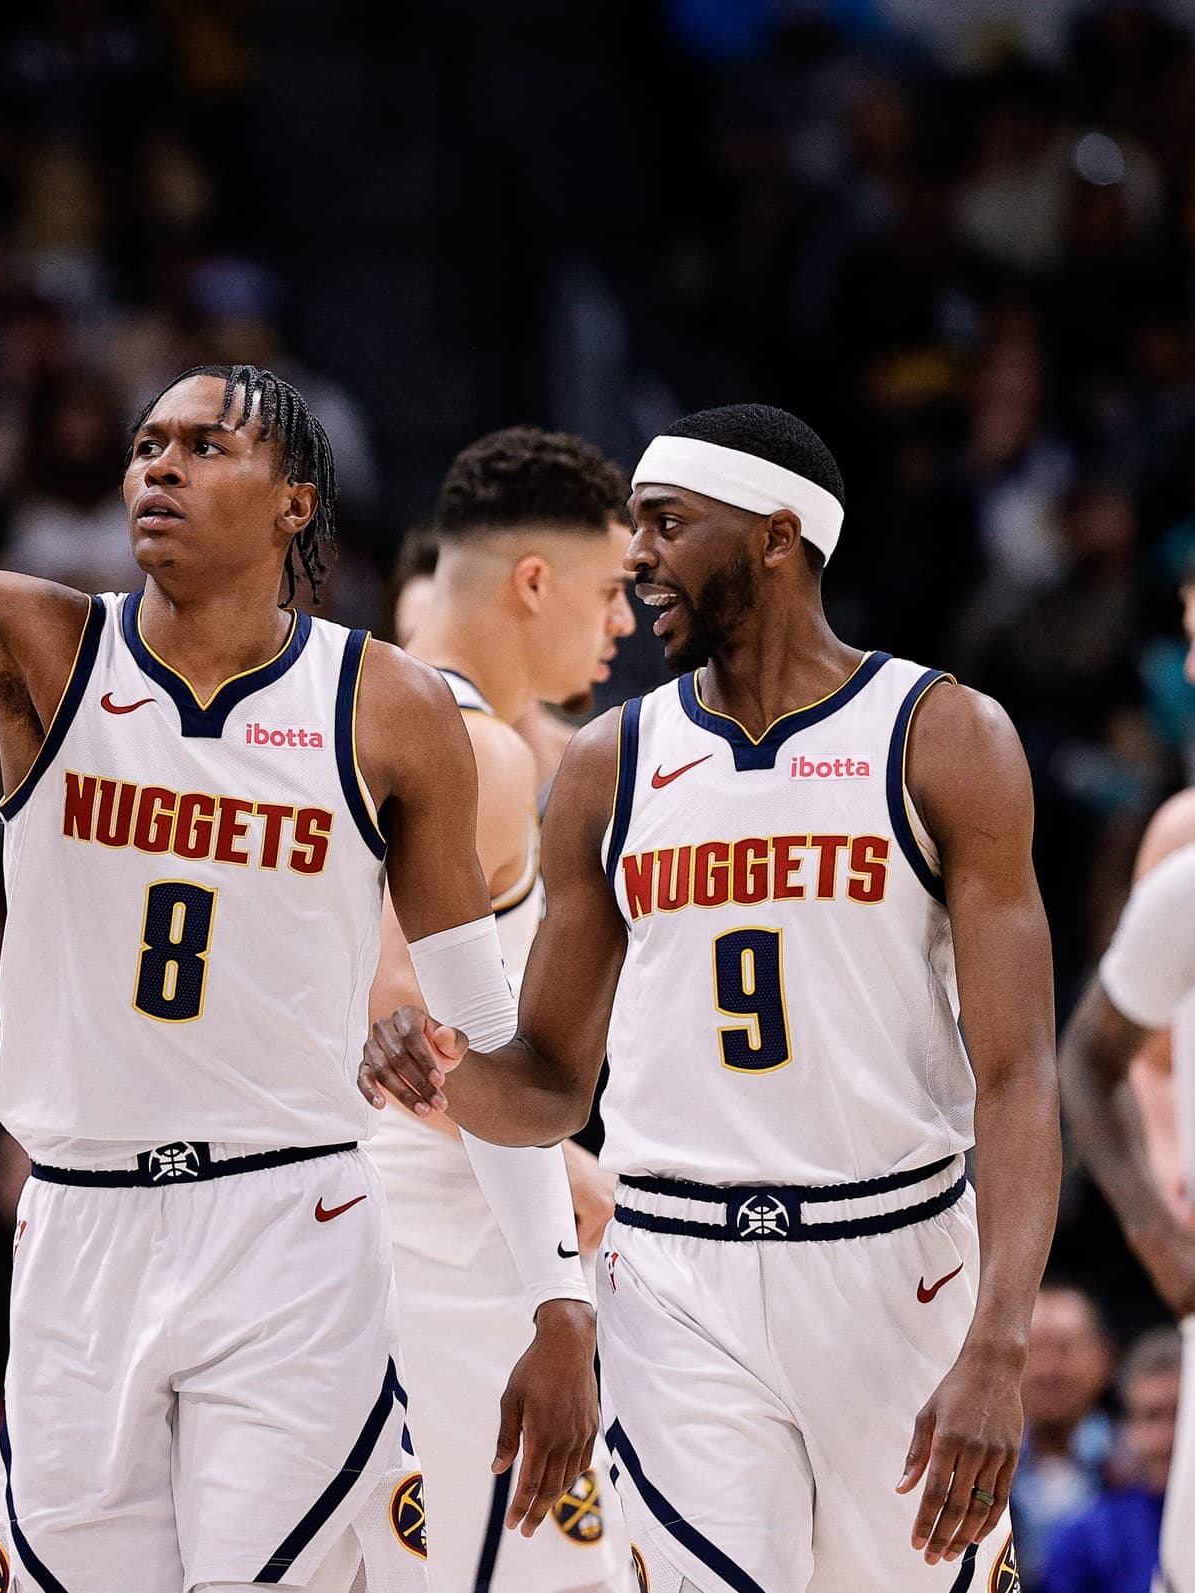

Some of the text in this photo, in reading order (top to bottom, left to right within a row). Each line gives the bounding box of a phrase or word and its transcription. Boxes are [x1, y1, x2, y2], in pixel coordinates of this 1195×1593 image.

[245, 723, 324, 748] ibotta
[790, 757, 870, 778] ibotta
[63, 769, 335, 876] NUGGETS
[622, 834, 891, 923] NUGGETS
[132, 879, 218, 1024] 8
[712, 926, 793, 1074] 9
